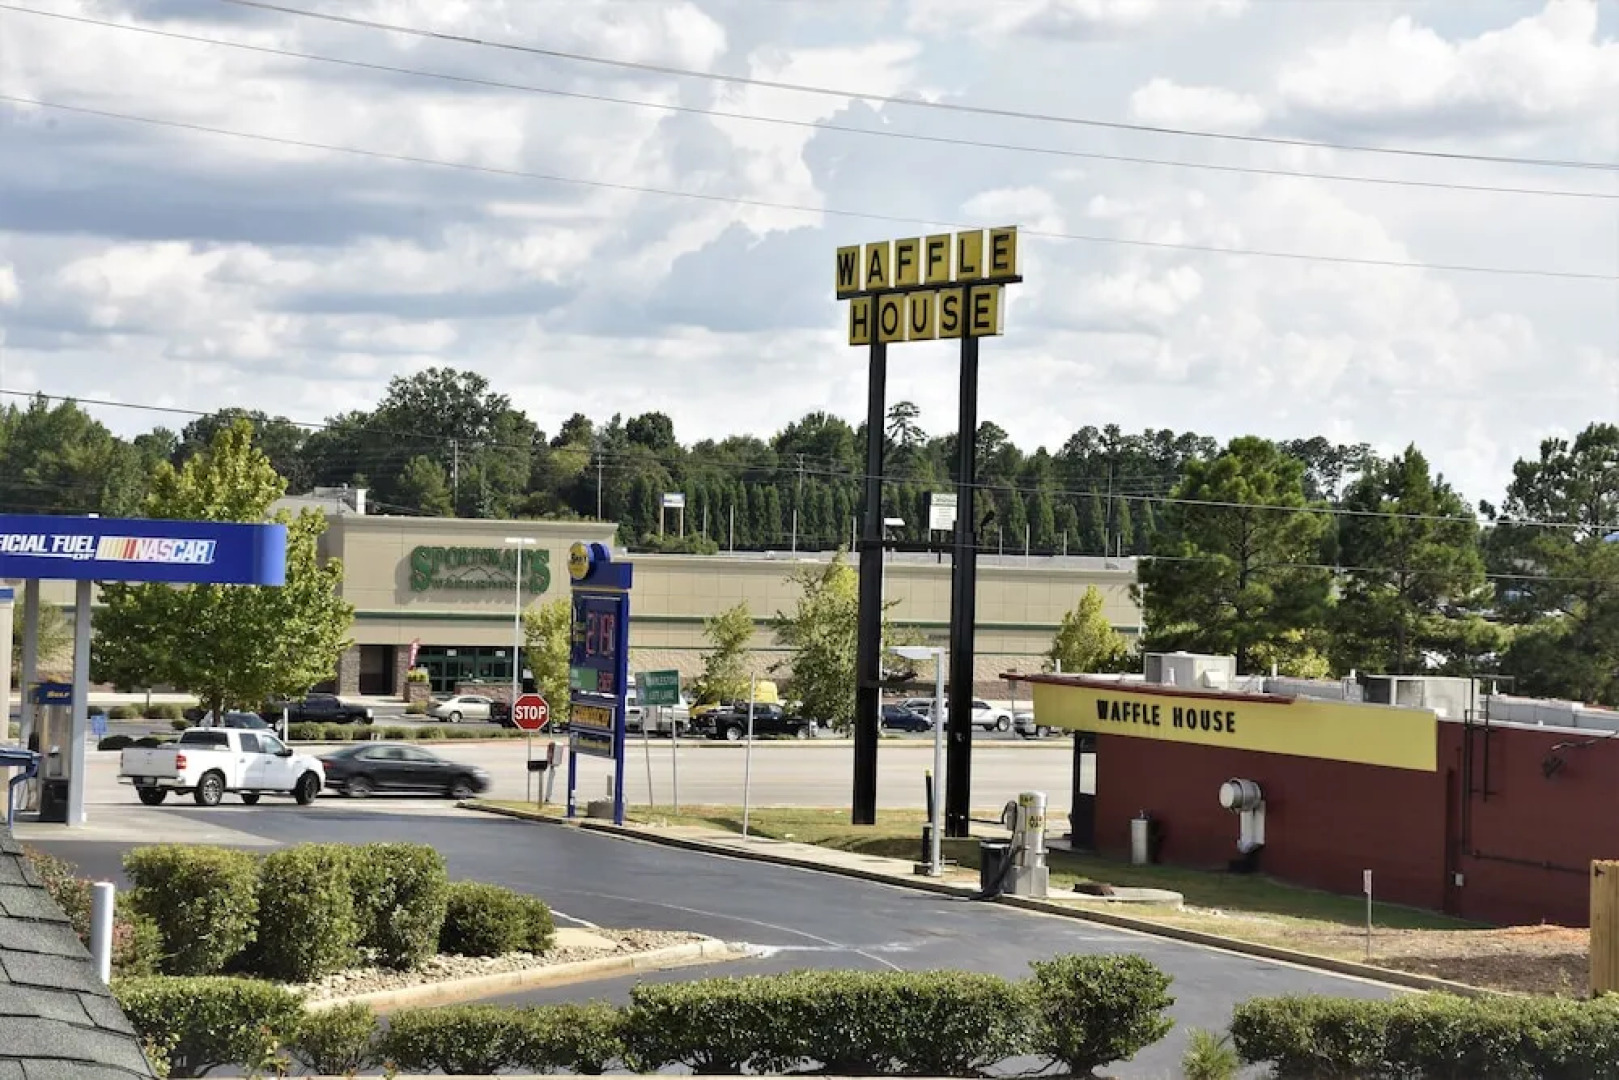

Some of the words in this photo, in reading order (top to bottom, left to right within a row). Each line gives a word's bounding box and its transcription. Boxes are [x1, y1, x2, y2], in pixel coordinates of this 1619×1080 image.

[837, 234, 1010, 286] WAFFLE
[852, 292, 991, 338] HOUSE
[51, 534, 96, 553] FUEL
[135, 540, 210, 562] NASCAR
[515, 705, 547, 720] STOP
[1096, 699, 1161, 726] WAFFLE
[1173, 706, 1236, 734] HOUSE
